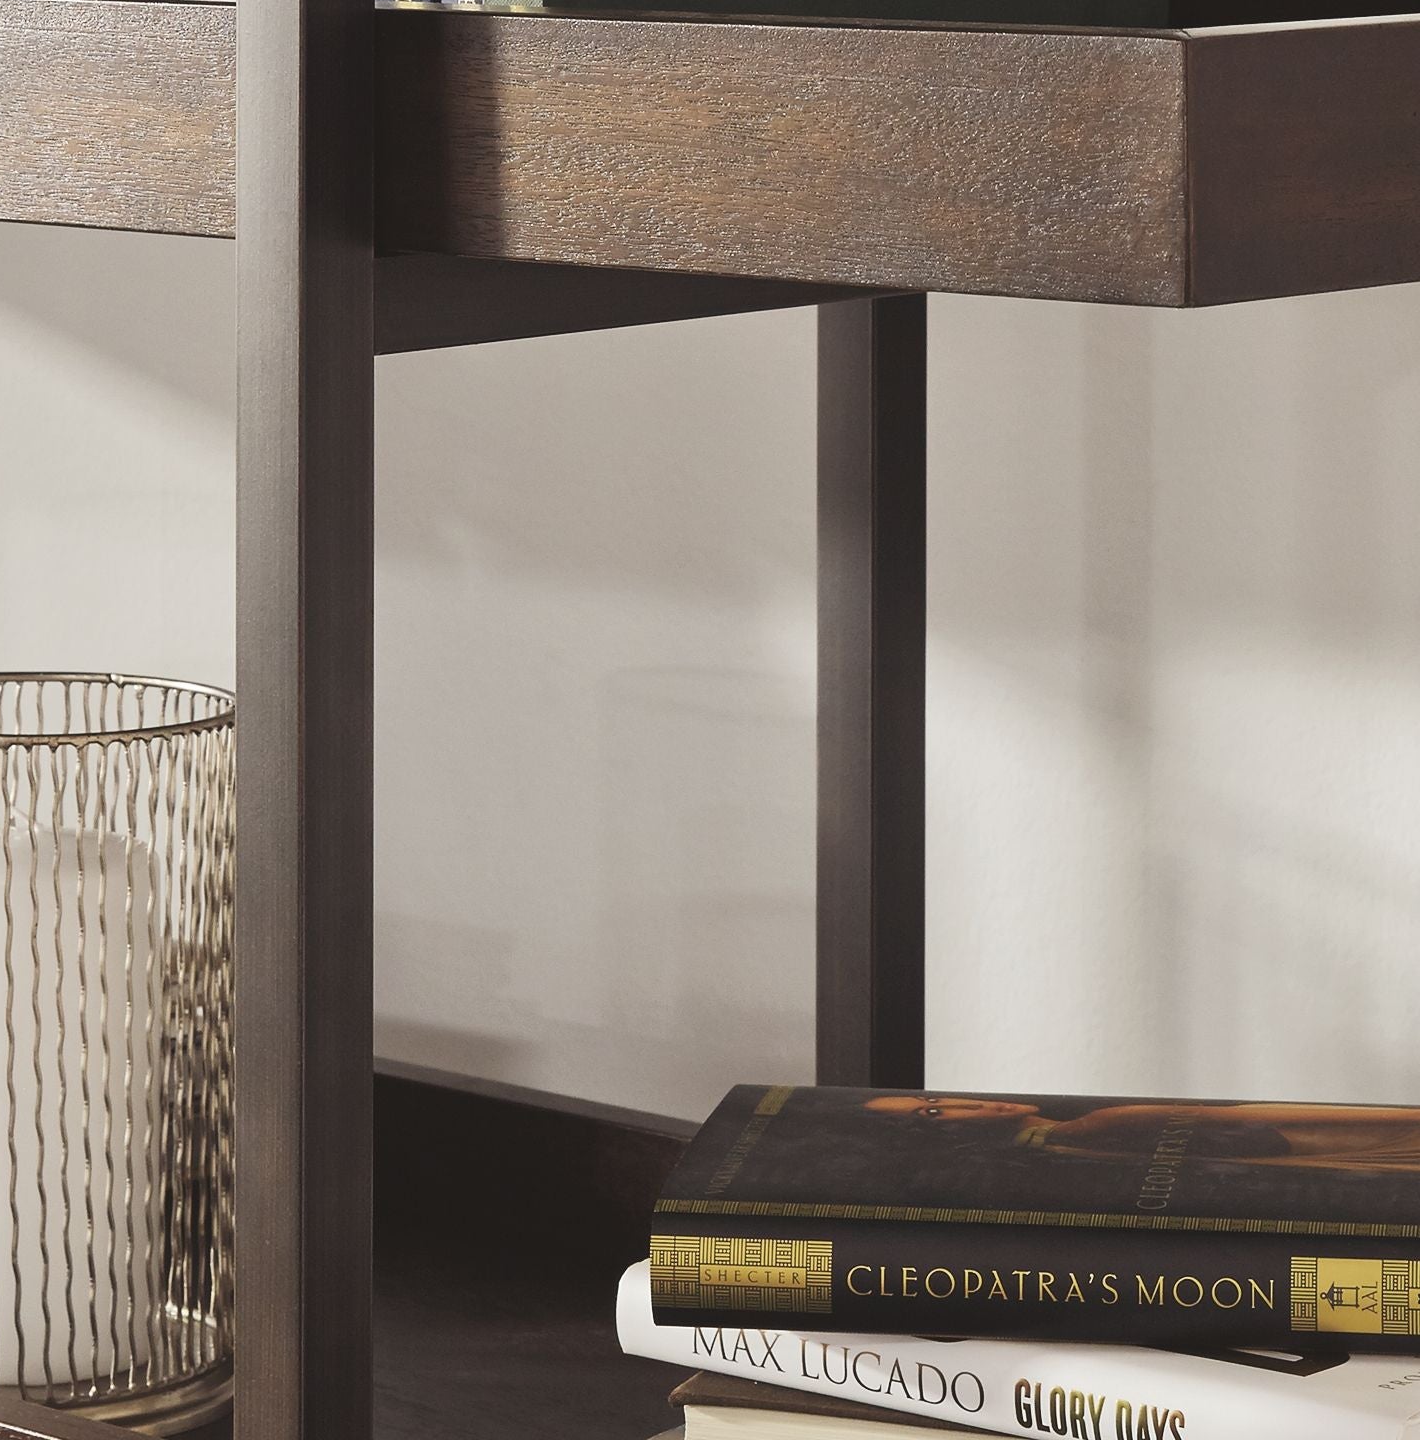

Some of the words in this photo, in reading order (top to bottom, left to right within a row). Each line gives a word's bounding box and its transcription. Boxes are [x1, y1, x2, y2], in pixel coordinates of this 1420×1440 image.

[703, 1267, 803, 1286] SHECTER
[847, 1263, 1118, 1306] CLEOPATRA'S
[1136, 1276, 1276, 1311] MOON
[1361, 1281, 1378, 1314] AAL
[691, 1326, 787, 1373] MAX
[799, 1338, 985, 1413] LUCADO
[1013, 1376, 1106, 1440] GLORY
